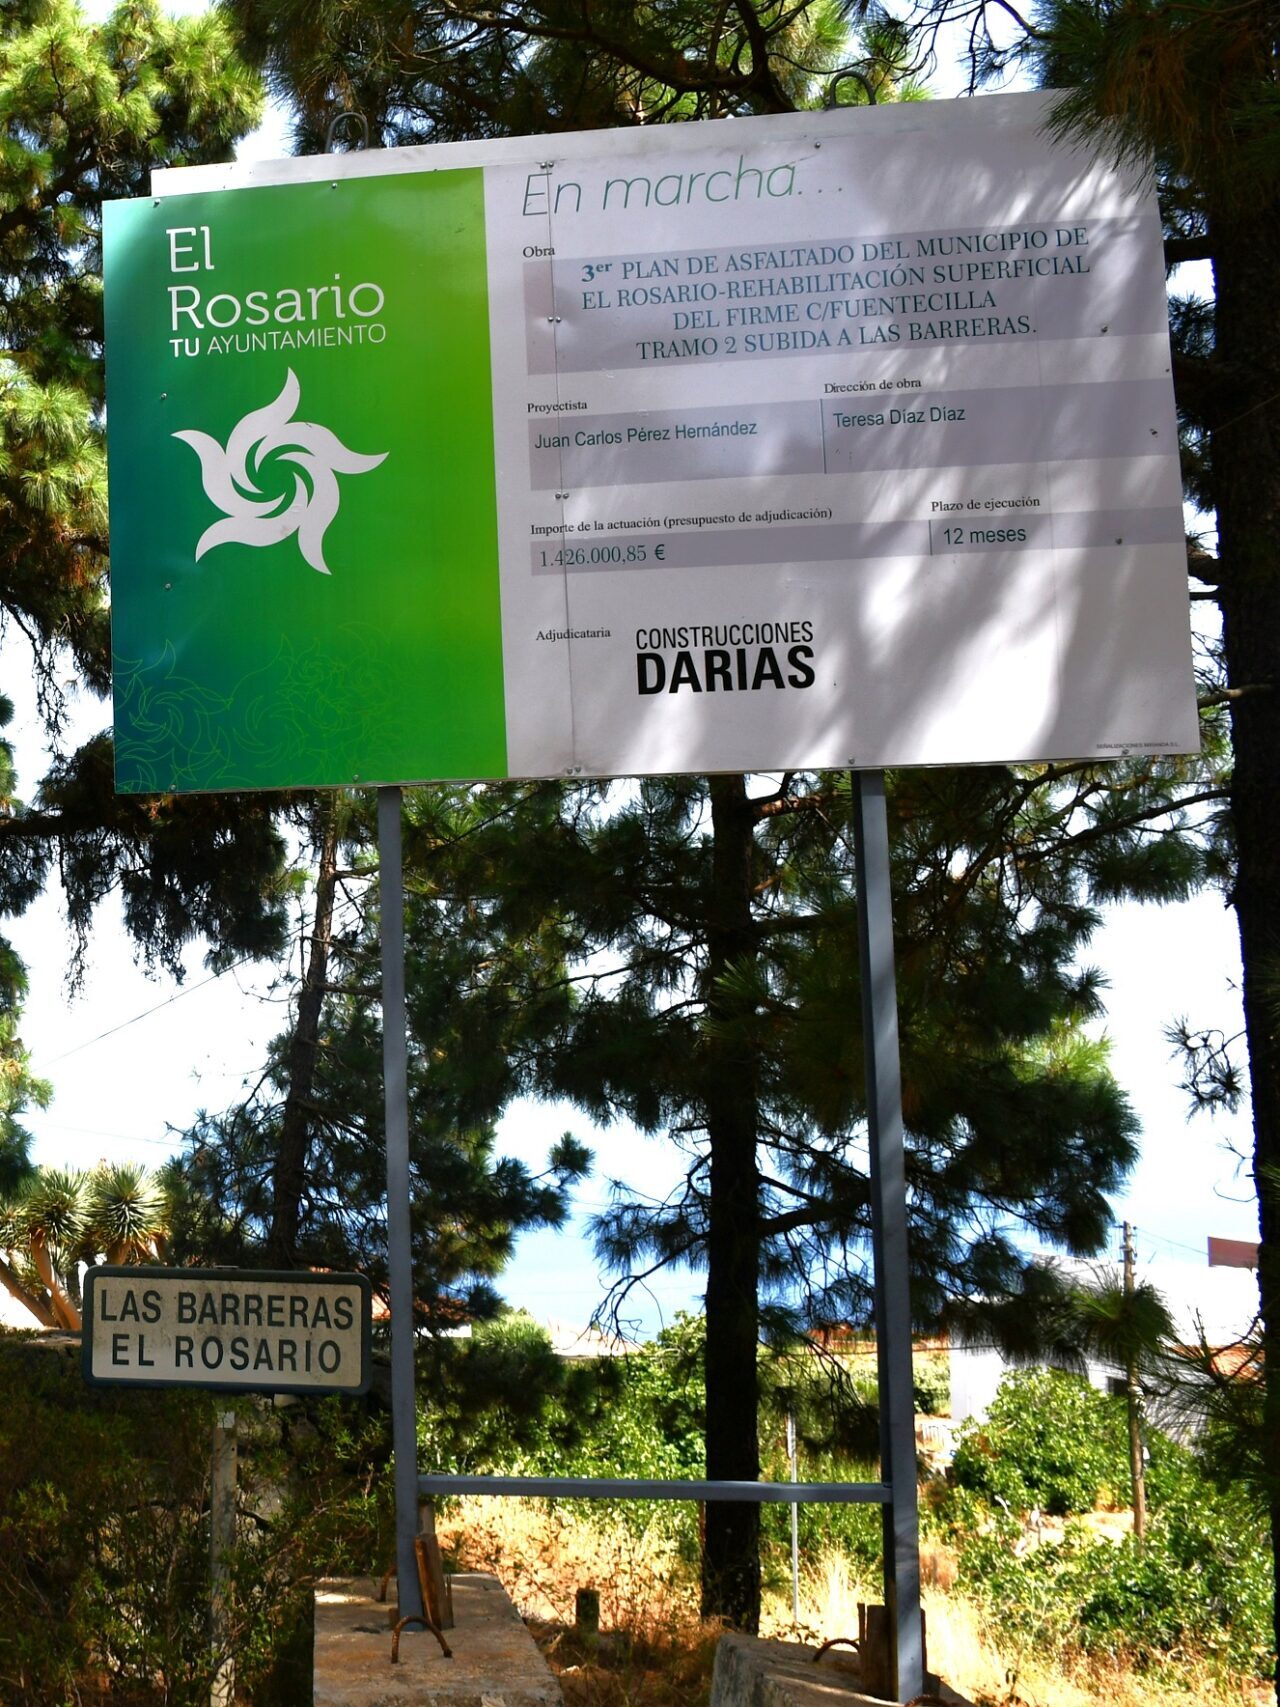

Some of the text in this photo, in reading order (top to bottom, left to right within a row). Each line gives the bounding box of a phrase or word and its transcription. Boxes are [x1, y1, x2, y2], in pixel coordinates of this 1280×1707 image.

[522, 172, 582, 216] En
[166, 226, 215, 272] El
[522, 244, 556, 258] Obra
[581, 227, 1089, 283] 3er PLAN DE ASFALTADO DEL MUNICIPIO DE
[582, 255, 1091, 310] EL ROSARIO-REHABILITACIÓN SUPERFICIAL
[167, 273, 385, 331] Rosario
[673, 290, 997, 331] DEL FIRME C/FUENTECILLA
[169, 323, 386, 358] TU AYUNTAMIENTO
[636, 314, 1037, 360] TRAMO 2 SUBIDA A LAS BARRERAS.
[824, 378, 922, 394] Dirección de obra
[527, 400, 588, 414] Proyectista
[833, 406, 966, 428] Teresa Díaz Díaz
[535, 421, 758, 449] Juan Carlos Pérez Hernández
[931, 496, 1041, 512] Plazo de ejecución
[531, 507, 833, 536] Importe de la actuación (presupuesto de adjudicación)
[943, 527, 1027, 545] 12 meses
[540, 543, 666, 567] 1.426.000,85 €
[536, 627, 611, 642] Adjudicataria
[636, 620, 814, 650] CONSTRUCCIONES
[636, 644, 816, 696] DARIAS
[100, 1289, 354, 1330] LAS BARRERAS
[112, 1333, 341, 1374] EL ROSARIO
